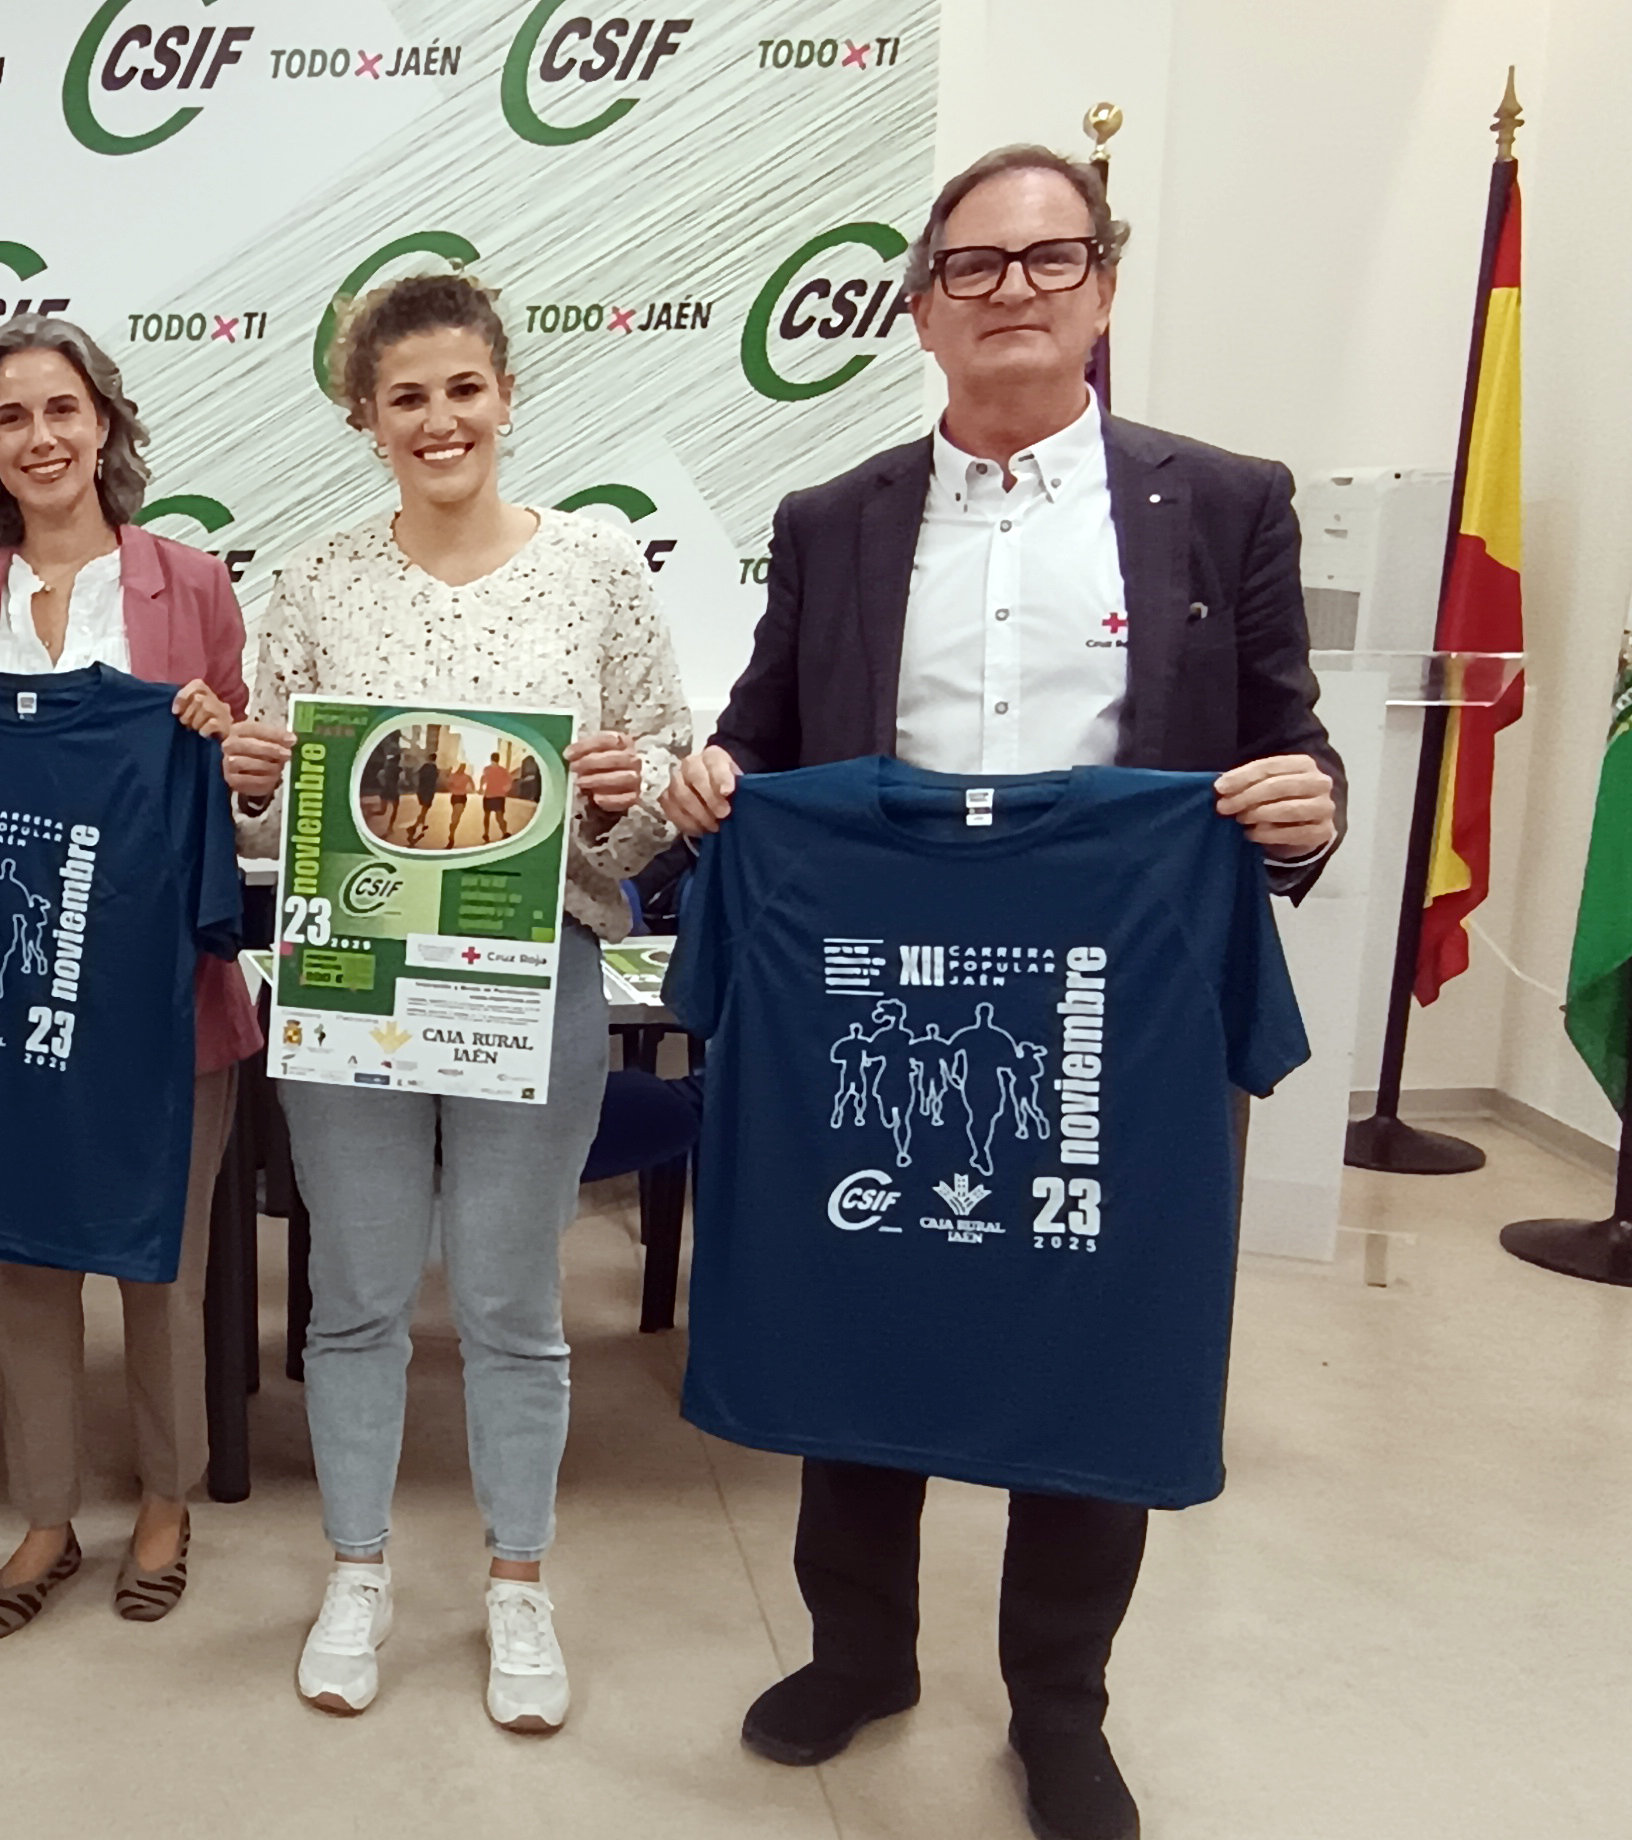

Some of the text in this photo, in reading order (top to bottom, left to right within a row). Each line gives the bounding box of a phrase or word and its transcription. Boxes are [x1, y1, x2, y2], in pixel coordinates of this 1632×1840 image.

[100, 24, 254, 91] CSIF
[539, 16, 693, 82] CSIF
[292, 743, 326, 894] noviembre
[51, 824, 100, 1002] noviembre
[355, 877, 403, 898] CSIF
[283, 896, 331, 946] 23
[949, 946, 1055, 958] CARRERA
[949, 960, 1055, 972] POPULAR
[25, 1006, 76, 1058] 23
[472, 1032, 534, 1050] RURAL
[1054, 946, 1108, 1164] noviembre
[842, 1188, 901, 1211] CSIF
[1032, 1176, 1102, 1235] 23
